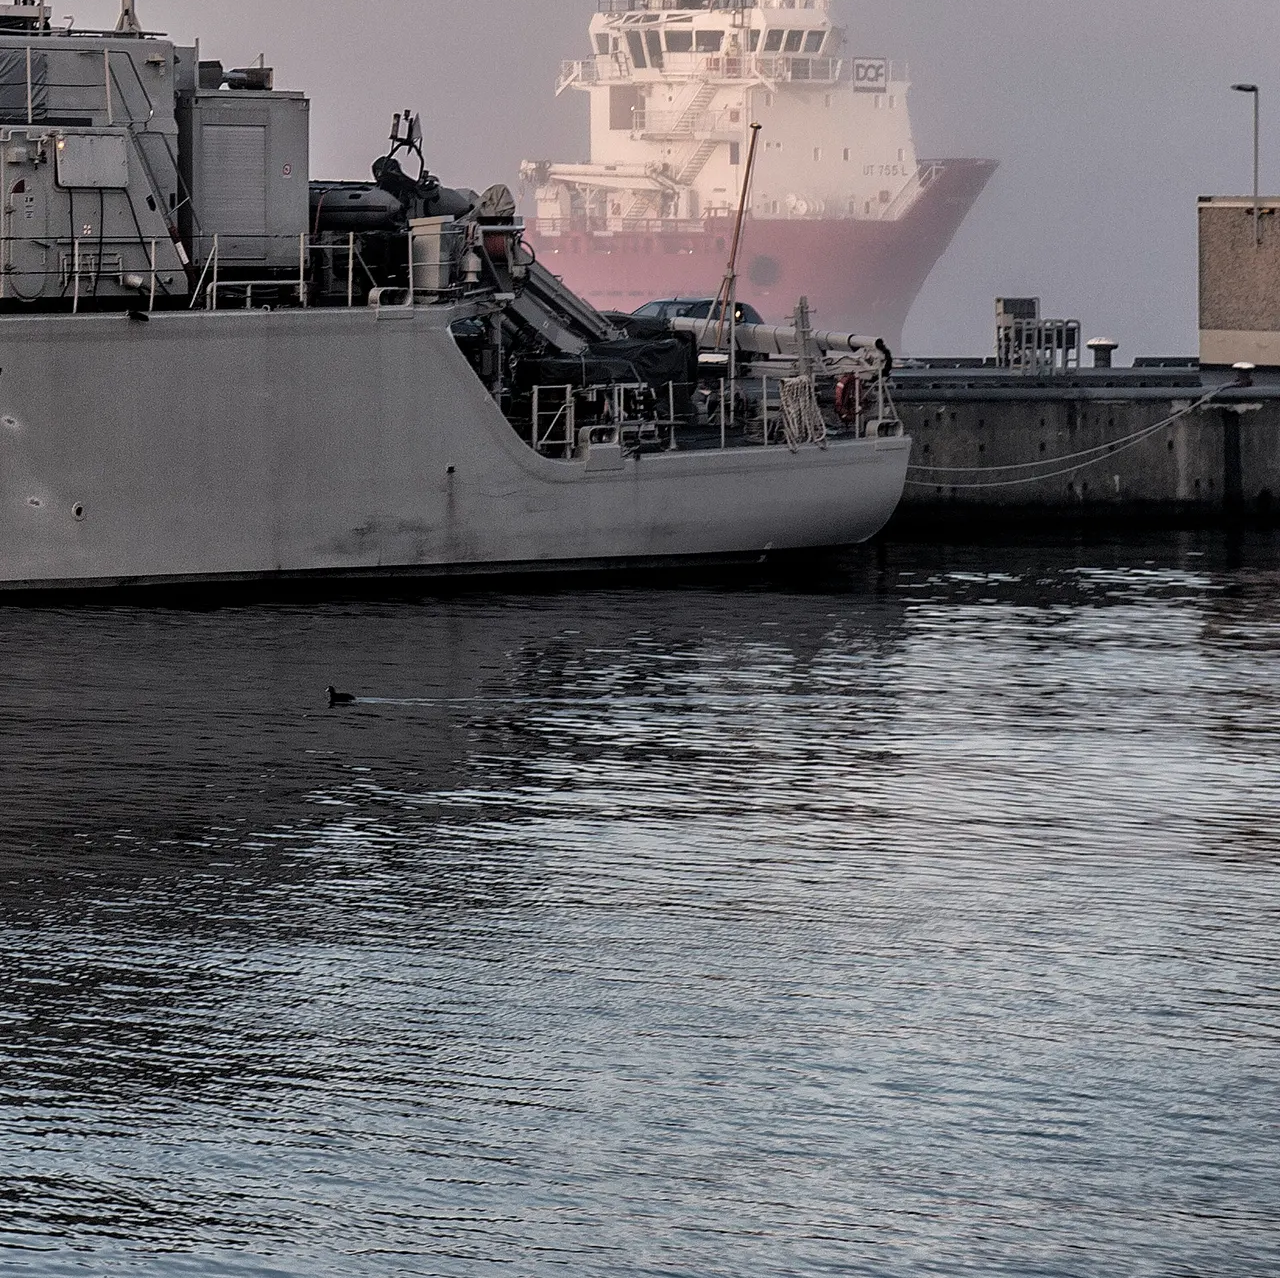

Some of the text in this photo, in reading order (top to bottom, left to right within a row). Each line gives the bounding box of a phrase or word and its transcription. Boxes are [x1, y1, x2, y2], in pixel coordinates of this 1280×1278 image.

[855, 64, 884, 82] DOF
[863, 165, 875, 176] UT
[901, 165, 908, 176] L
